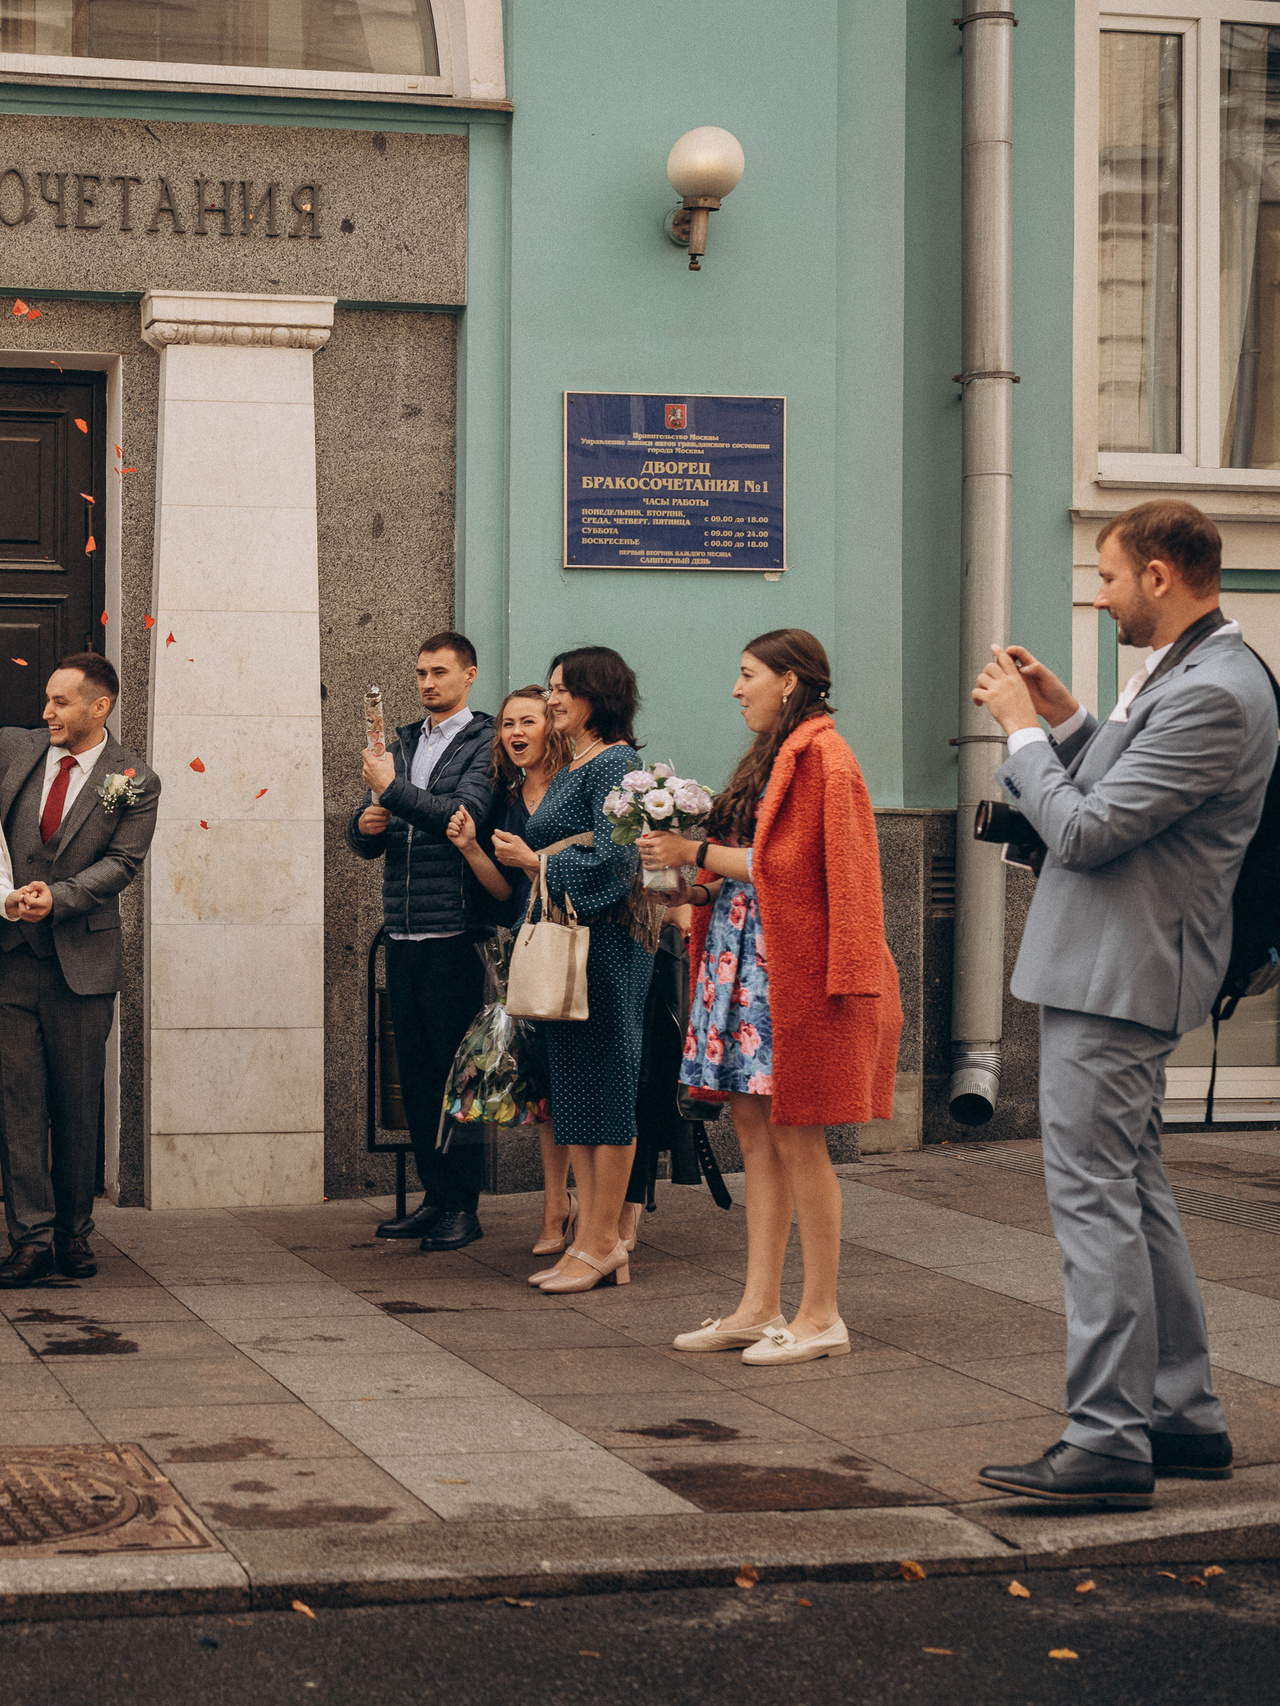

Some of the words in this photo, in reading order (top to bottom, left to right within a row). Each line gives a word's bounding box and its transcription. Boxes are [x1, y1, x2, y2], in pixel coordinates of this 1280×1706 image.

[632, 432, 689, 440] Правительство
[689, 433, 719, 441] Москвы
[581, 438, 625, 446] Управление
[641, 461, 711, 477] ДВОРЕЦ
[582, 476, 739, 492] БРАКОСОЧЕТАНИЯ
[642, 498, 670, 506] ЧАСЫ
[672, 498, 709, 506] РАБОТЫ
[581, 537, 640, 545] ВОСКРЕСЕНЬЕ
[640, 557, 690, 565] САНИТАРНЫЙ
